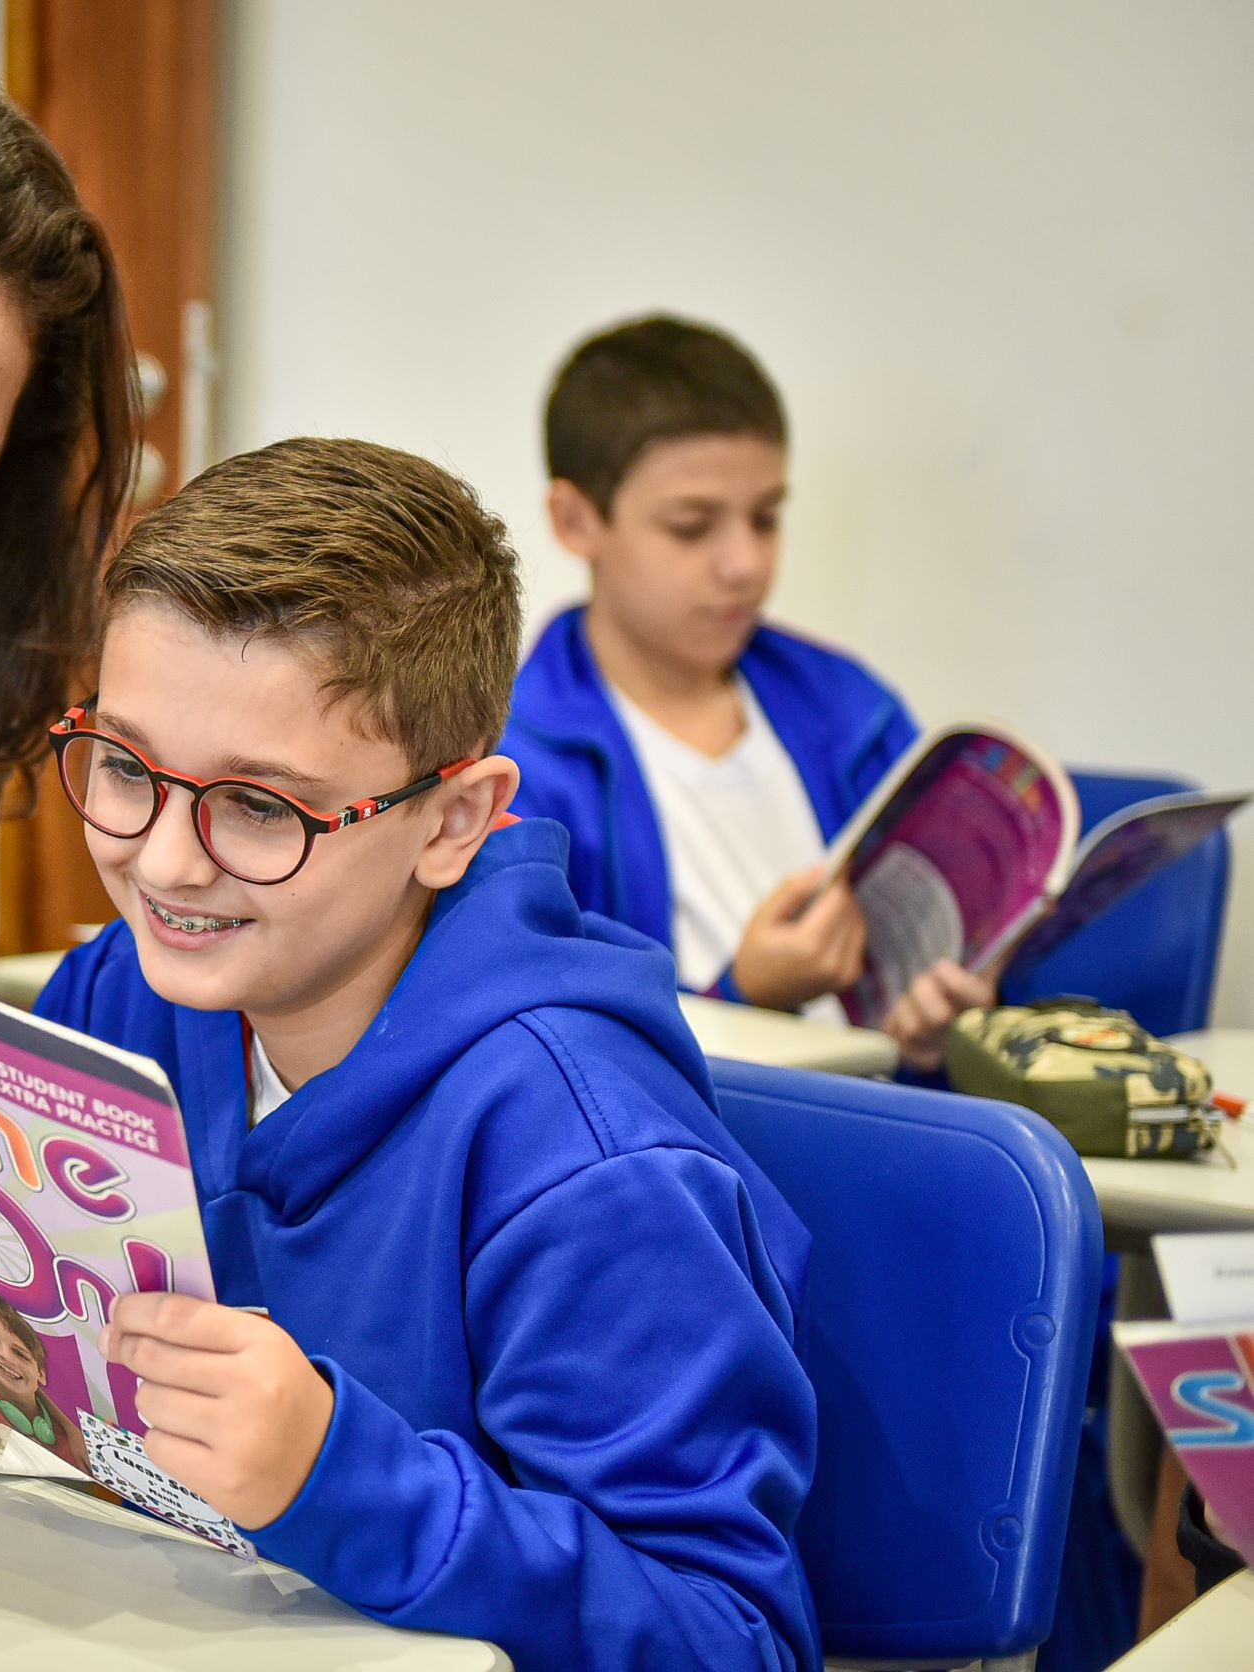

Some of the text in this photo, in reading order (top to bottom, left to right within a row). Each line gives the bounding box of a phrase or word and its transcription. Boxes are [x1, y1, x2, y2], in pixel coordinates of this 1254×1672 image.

[55, 1103, 160, 1153] PRACTICE
[92, 1099, 157, 1135] BOOK
[113, 1450, 164, 1483] Lucas
